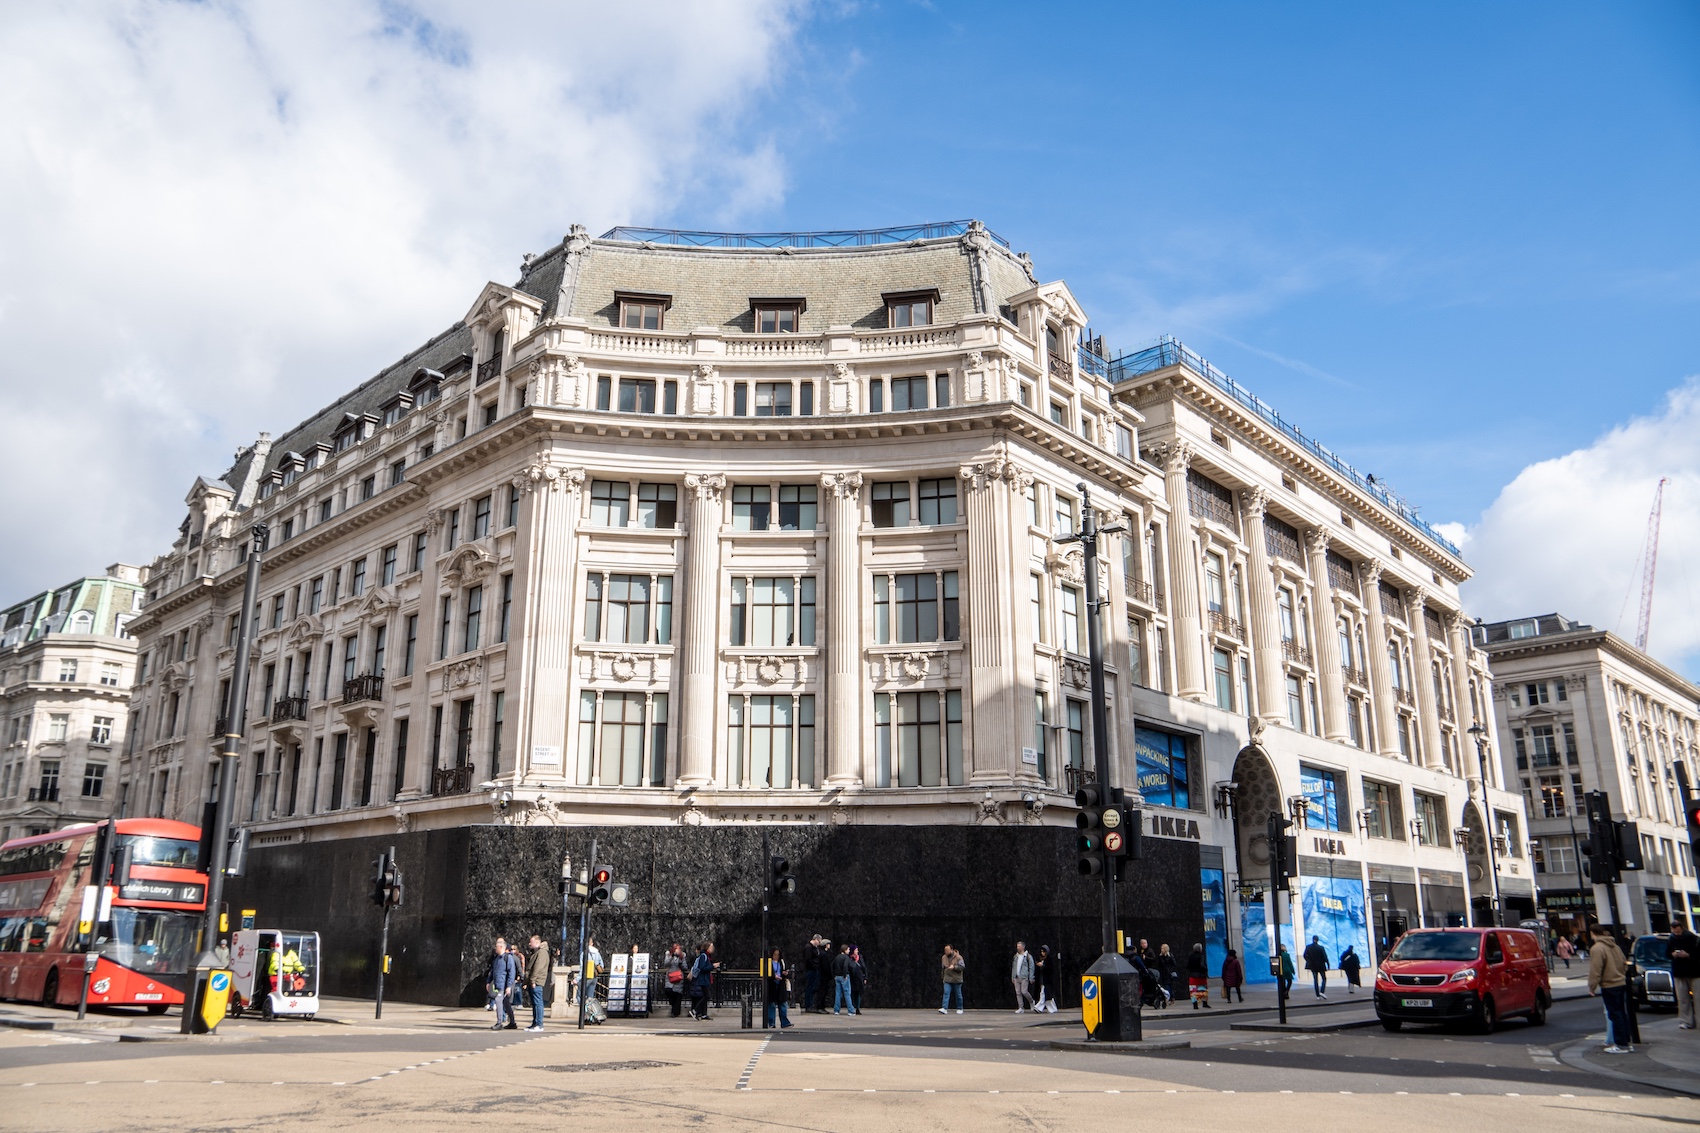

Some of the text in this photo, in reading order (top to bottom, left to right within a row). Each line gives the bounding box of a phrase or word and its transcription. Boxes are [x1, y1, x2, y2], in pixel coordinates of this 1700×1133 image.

[1143, 773, 1168, 787] WORLD
[1302, 783, 1314, 793] FULL
[1308, 801, 1323, 815] ONDER
[719, 813, 816, 822] NIKETOWN
[1153, 815, 1201, 839] IKEA
[1314, 837, 1346, 855] IKEA
[150, 886, 174, 896] Library
[182, 887, 196, 899] 12
[1202, 888, 1212, 901] EW
[1322, 897, 1344, 911] IKEA
[1204, 918, 1216, 931] WN
